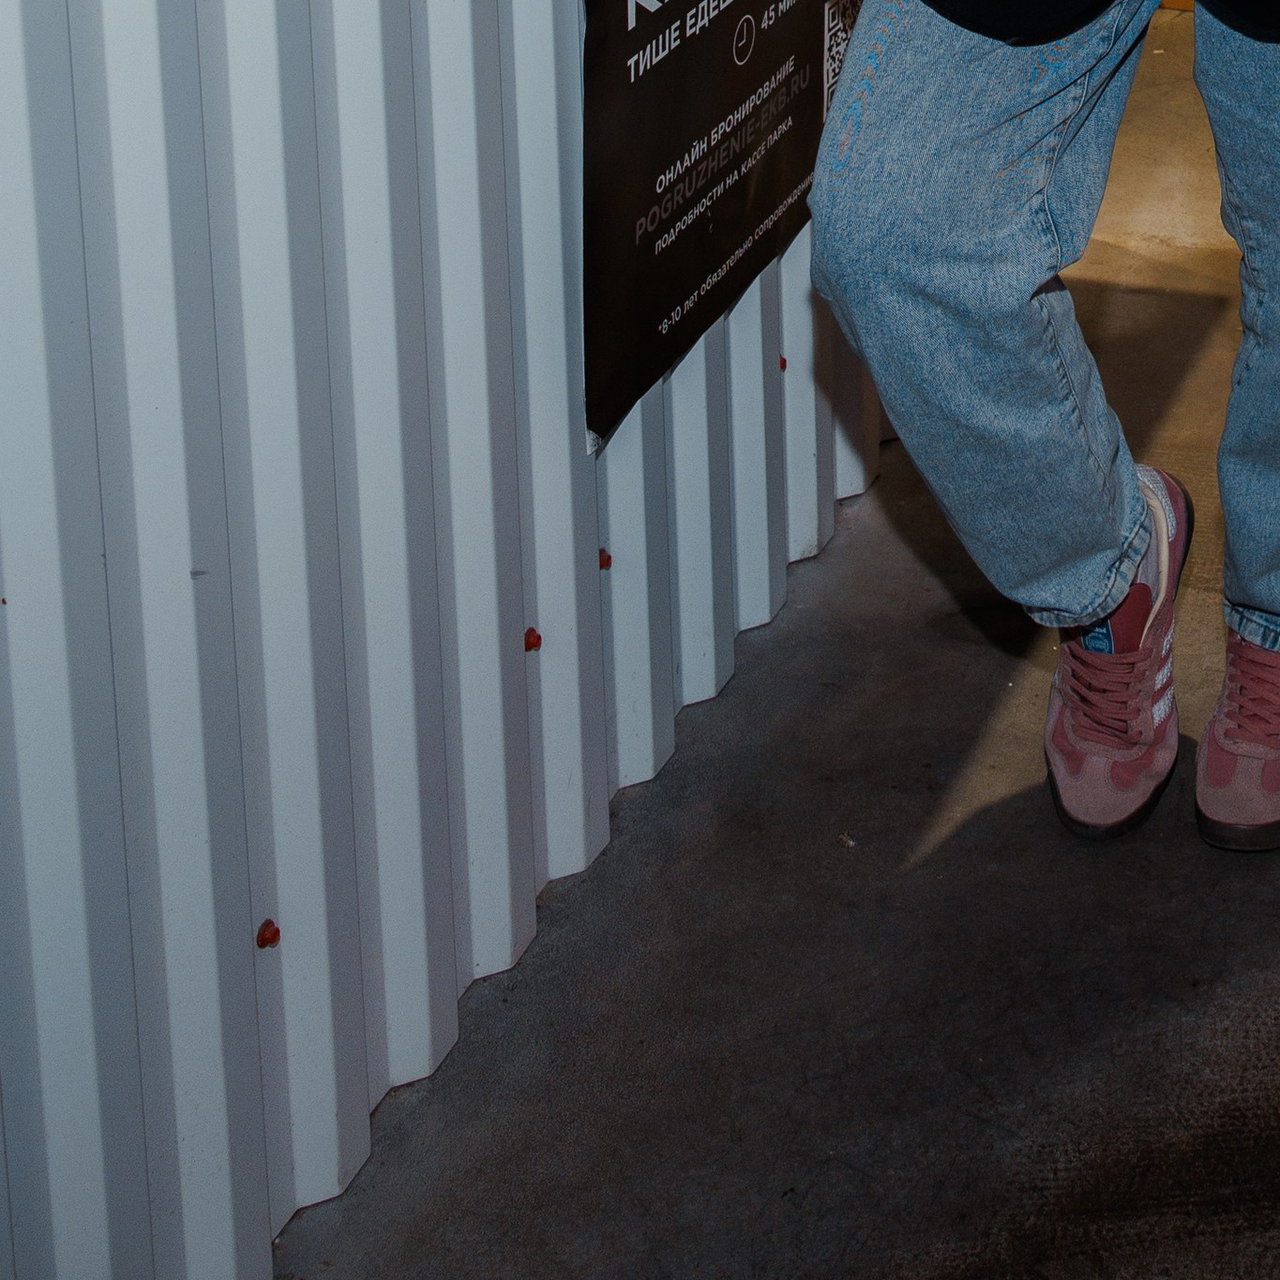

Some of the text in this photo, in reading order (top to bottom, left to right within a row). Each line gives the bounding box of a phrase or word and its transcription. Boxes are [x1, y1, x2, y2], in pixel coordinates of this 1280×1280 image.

[626, 19, 681, 84] ТИШЕ
[761, 8, 776, 30] 45
[655, 54, 796, 194] ОНЛАЙН БРОНИРОВАНИЕ
[654, 116, 793, 256] ПОДРОБНОСТИ НА КАССЕ ПАРКА
[683, 290, 699, 312] лет
[700, 235, 753, 295] обязательно
